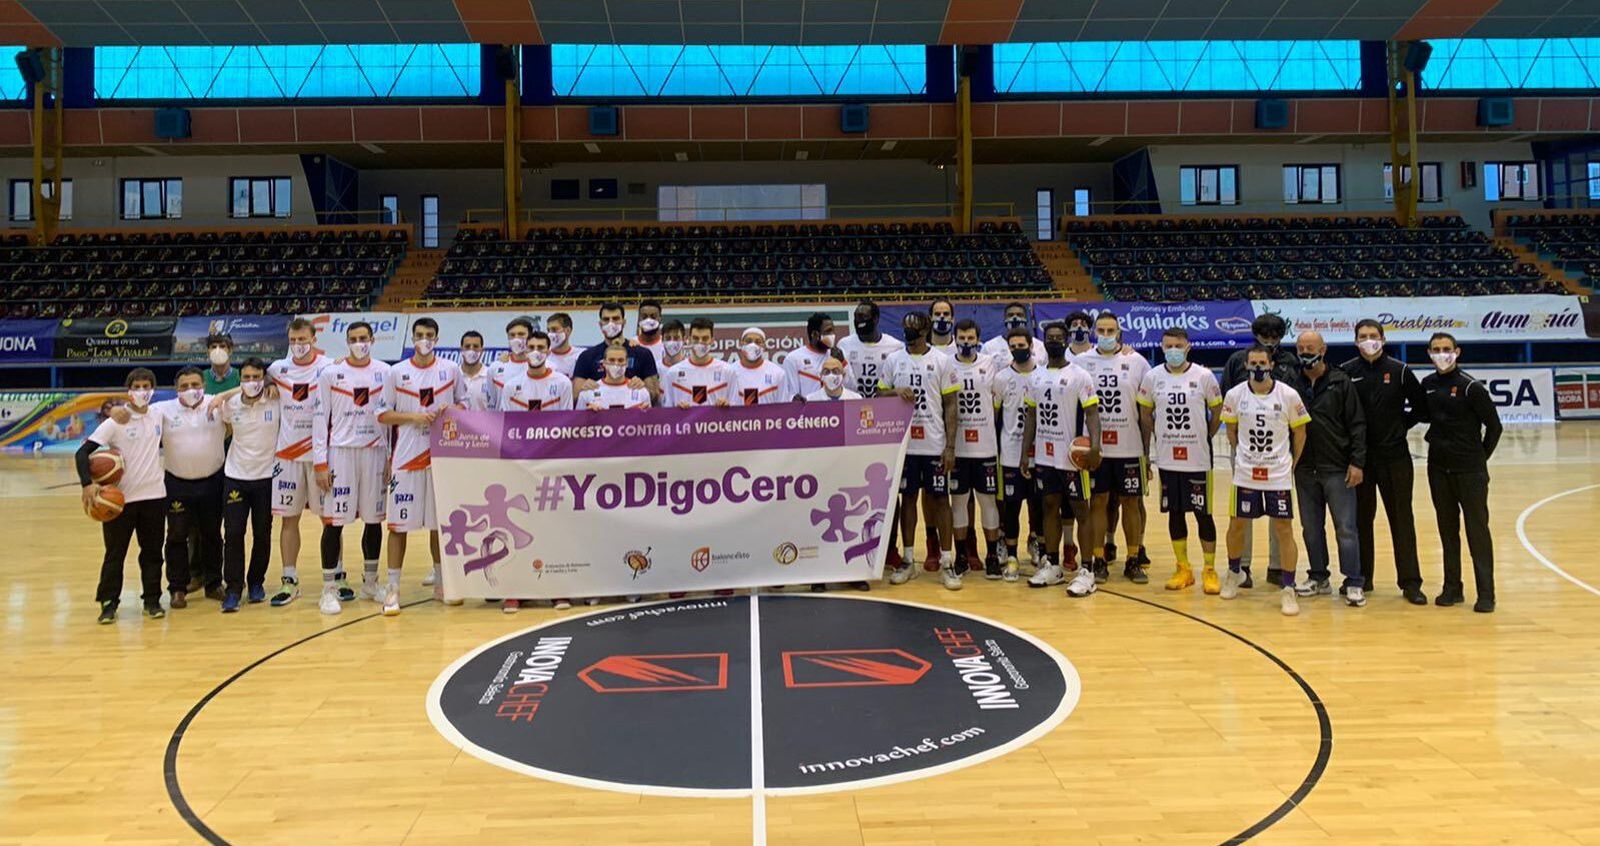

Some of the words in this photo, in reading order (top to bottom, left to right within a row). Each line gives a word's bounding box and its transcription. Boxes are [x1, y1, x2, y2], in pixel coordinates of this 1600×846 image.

[862, 363, 877, 377] 12
[909, 374, 922, 387] 13
[963, 379, 975, 391] 11
[1098, 374, 1118, 388] 33
[1044, 388, 1052, 401] 4
[1168, 392, 1186, 406] 30
[508, 428, 522, 440] EL
[526, 424, 613, 440] BALONCESTO
[617, 422, 672, 438] CONTRA
[675, 422, 692, 436] LA
[695, 418, 762, 434] VIOLENCIA
[766, 417, 782, 431] DE
[786, 413, 840, 429] GÉNERO
[876, 420, 895, 428] Junta
[1256, 414, 1266, 428] 5
[459, 432, 479, 441] Junta
[856, 427, 881, 435] Castilla
[438, 438, 464, 448] Castilla
[932, 475, 945, 487] 13
[986, 476, 996, 488] 11
[1068, 481, 1077, 493] 4
[1125, 477, 1140, 489] 33
[534, 466, 819, 516] #YoDigoCero
[280, 494, 293, 506] 12
[394, 493, 414, 505] gaza
[1191, 493, 1205, 507] 30
[1278, 499, 1287, 511] 5
[335, 502, 348, 514] 15
[400, 508, 408, 520] 6
[933, 626, 1020, 710] INNOVACHEF
[496, 636, 573, 723] INNOVACHEF
[799, 725, 985, 774] innovachef.com
